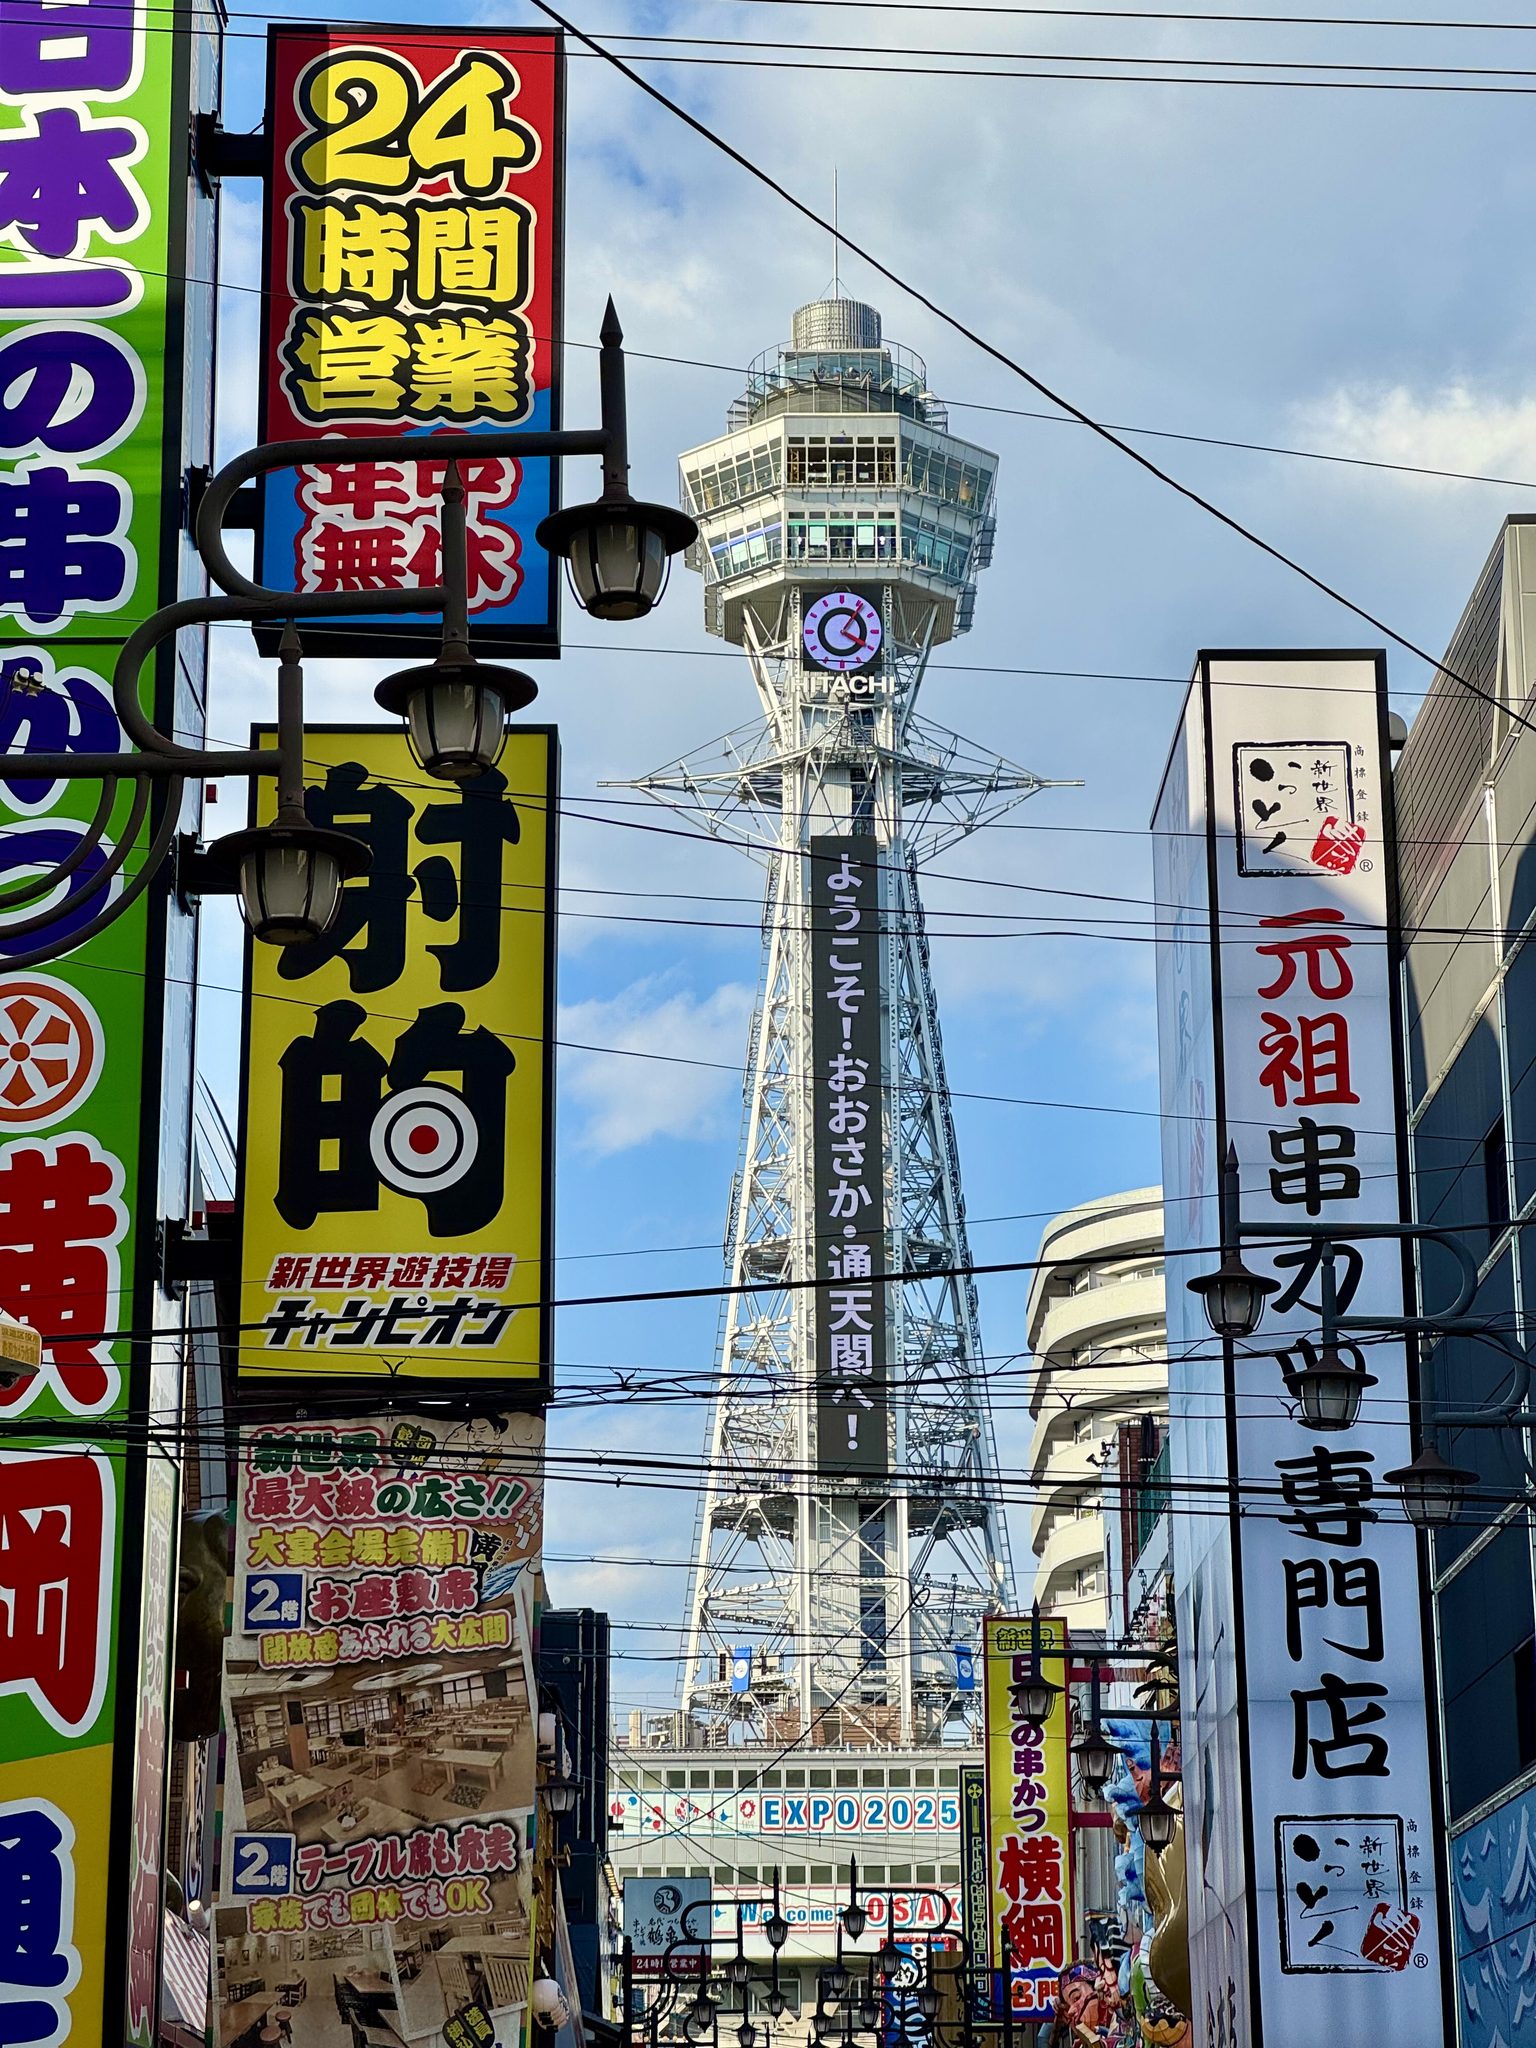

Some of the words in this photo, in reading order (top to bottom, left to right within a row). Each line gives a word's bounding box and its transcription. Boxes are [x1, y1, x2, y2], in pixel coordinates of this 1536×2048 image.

[298, 54, 529, 191] 24
[298, 203, 522, 304] 時間
[294, 314, 520, 415] 営業
[790, 675, 895, 693] HITACHI
[1310, 760, 1338, 814] 新世界
[1354, 744, 1369, 822] 商標登録
[274, 760, 521, 1238] 射的
[268, 1255, 513, 1289] 新世界遊技場
[267, 1296, 514, 1345] チャンピオン
[248, 1579, 299, 1622] 2階
[309, 1569, 479, 1621] お座敷席
[261, 1614, 508, 1664] 開放感あふれる大広間
[1011, 1653, 1046, 1833] 日の串かつ
[236, 1842, 288, 1888] 2階
[299, 1826, 514, 1889] テーブル席も充実
[1359, 1835, 1390, 1899] 新世界
[1406, 1818, 1424, 1910] 商標登録
[251, 1879, 489, 1933] 家族でも団体でもOK
[739, 1903, 833, 1922] Wecome
[867, 1896, 960, 1921] OSAK
[999, 1835, 1062, 1970] 横綱
[636, 1958, 698, 1969] 24時営業中
